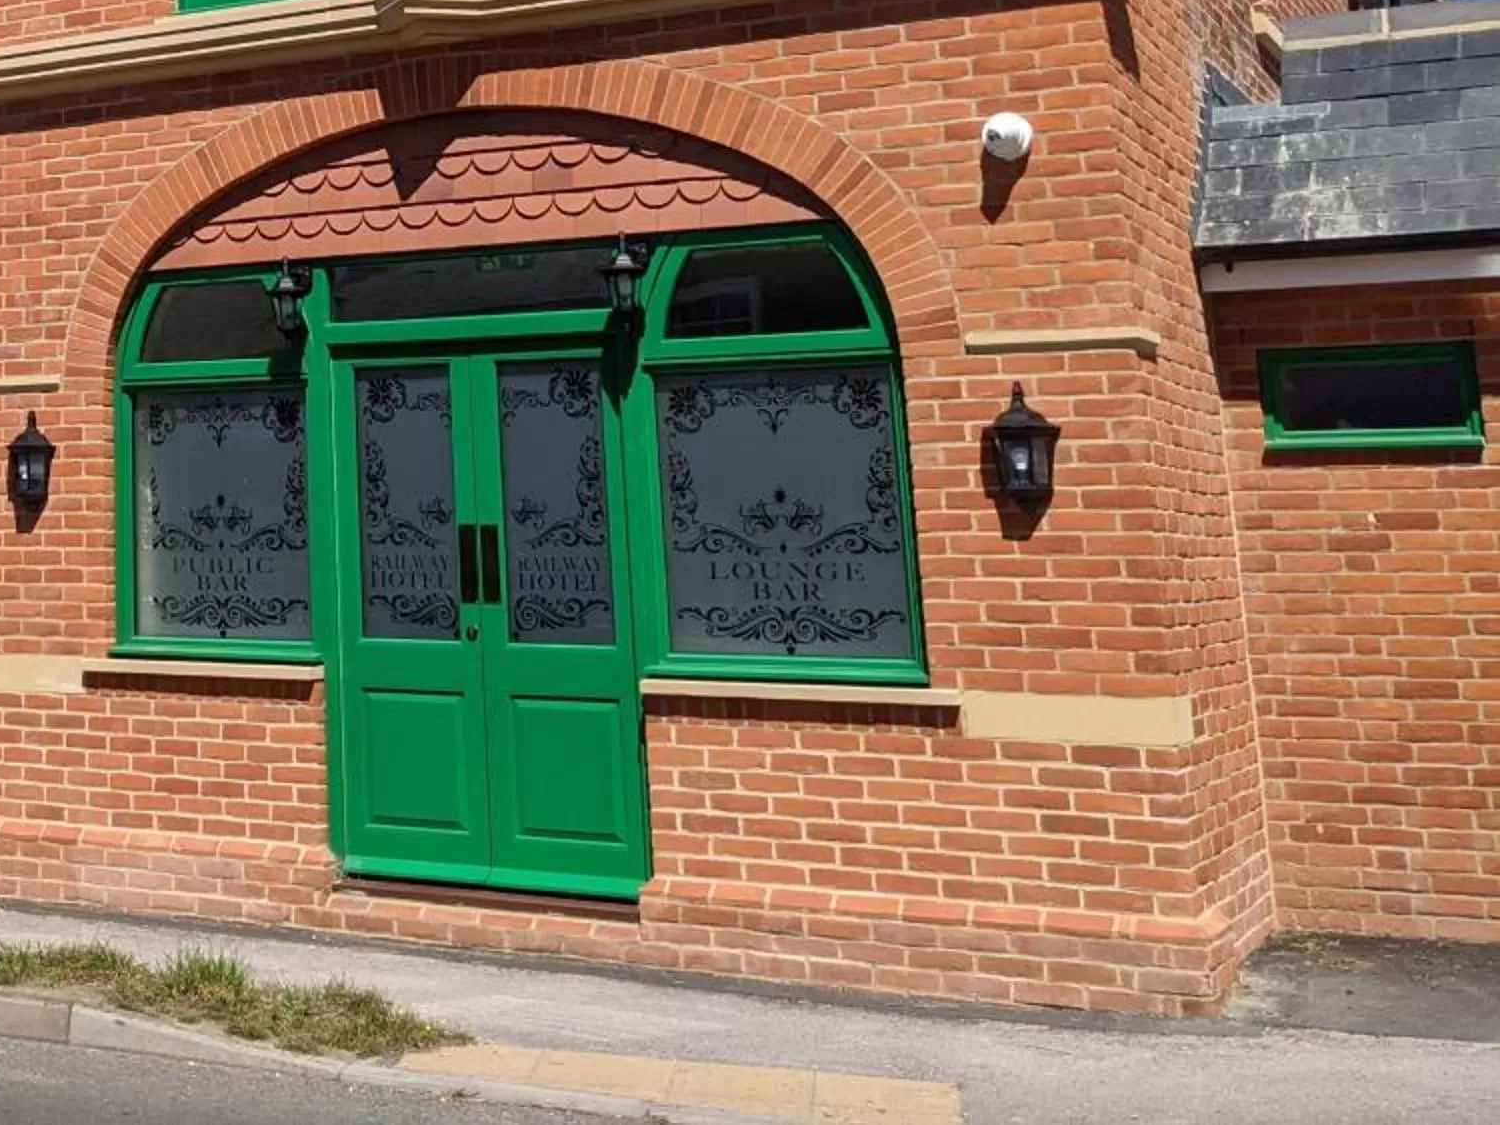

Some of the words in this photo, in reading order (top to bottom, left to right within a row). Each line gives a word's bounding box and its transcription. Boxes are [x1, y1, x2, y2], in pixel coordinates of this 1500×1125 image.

[172, 557, 275, 574] PUBLIC
[710, 561, 866, 581] LOUNGE
[197, 575, 249, 592] BAR
[753, 581, 821, 601] BAR
